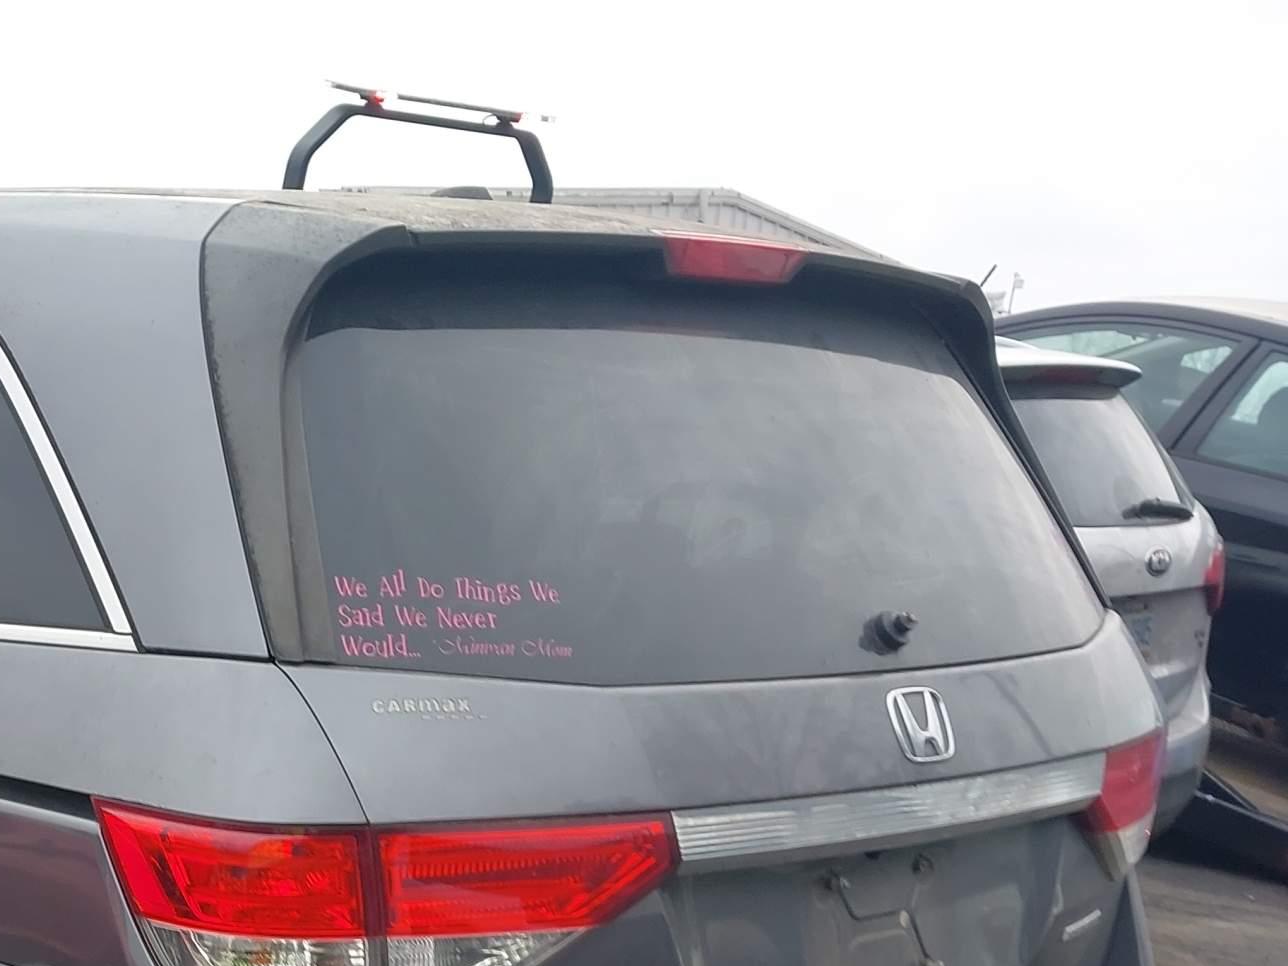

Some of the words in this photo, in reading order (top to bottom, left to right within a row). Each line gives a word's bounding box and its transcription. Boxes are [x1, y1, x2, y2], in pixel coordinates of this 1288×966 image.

[334, 575, 368, 598] We
[380, 568, 406, 597] All
[417, 576, 444, 598] Do
[455, 576, 522, 605] Things
[528, 579, 561, 604] We
[338, 603, 385, 627] Said
[395, 604, 428, 628] We
[437, 606, 497, 629] Never
